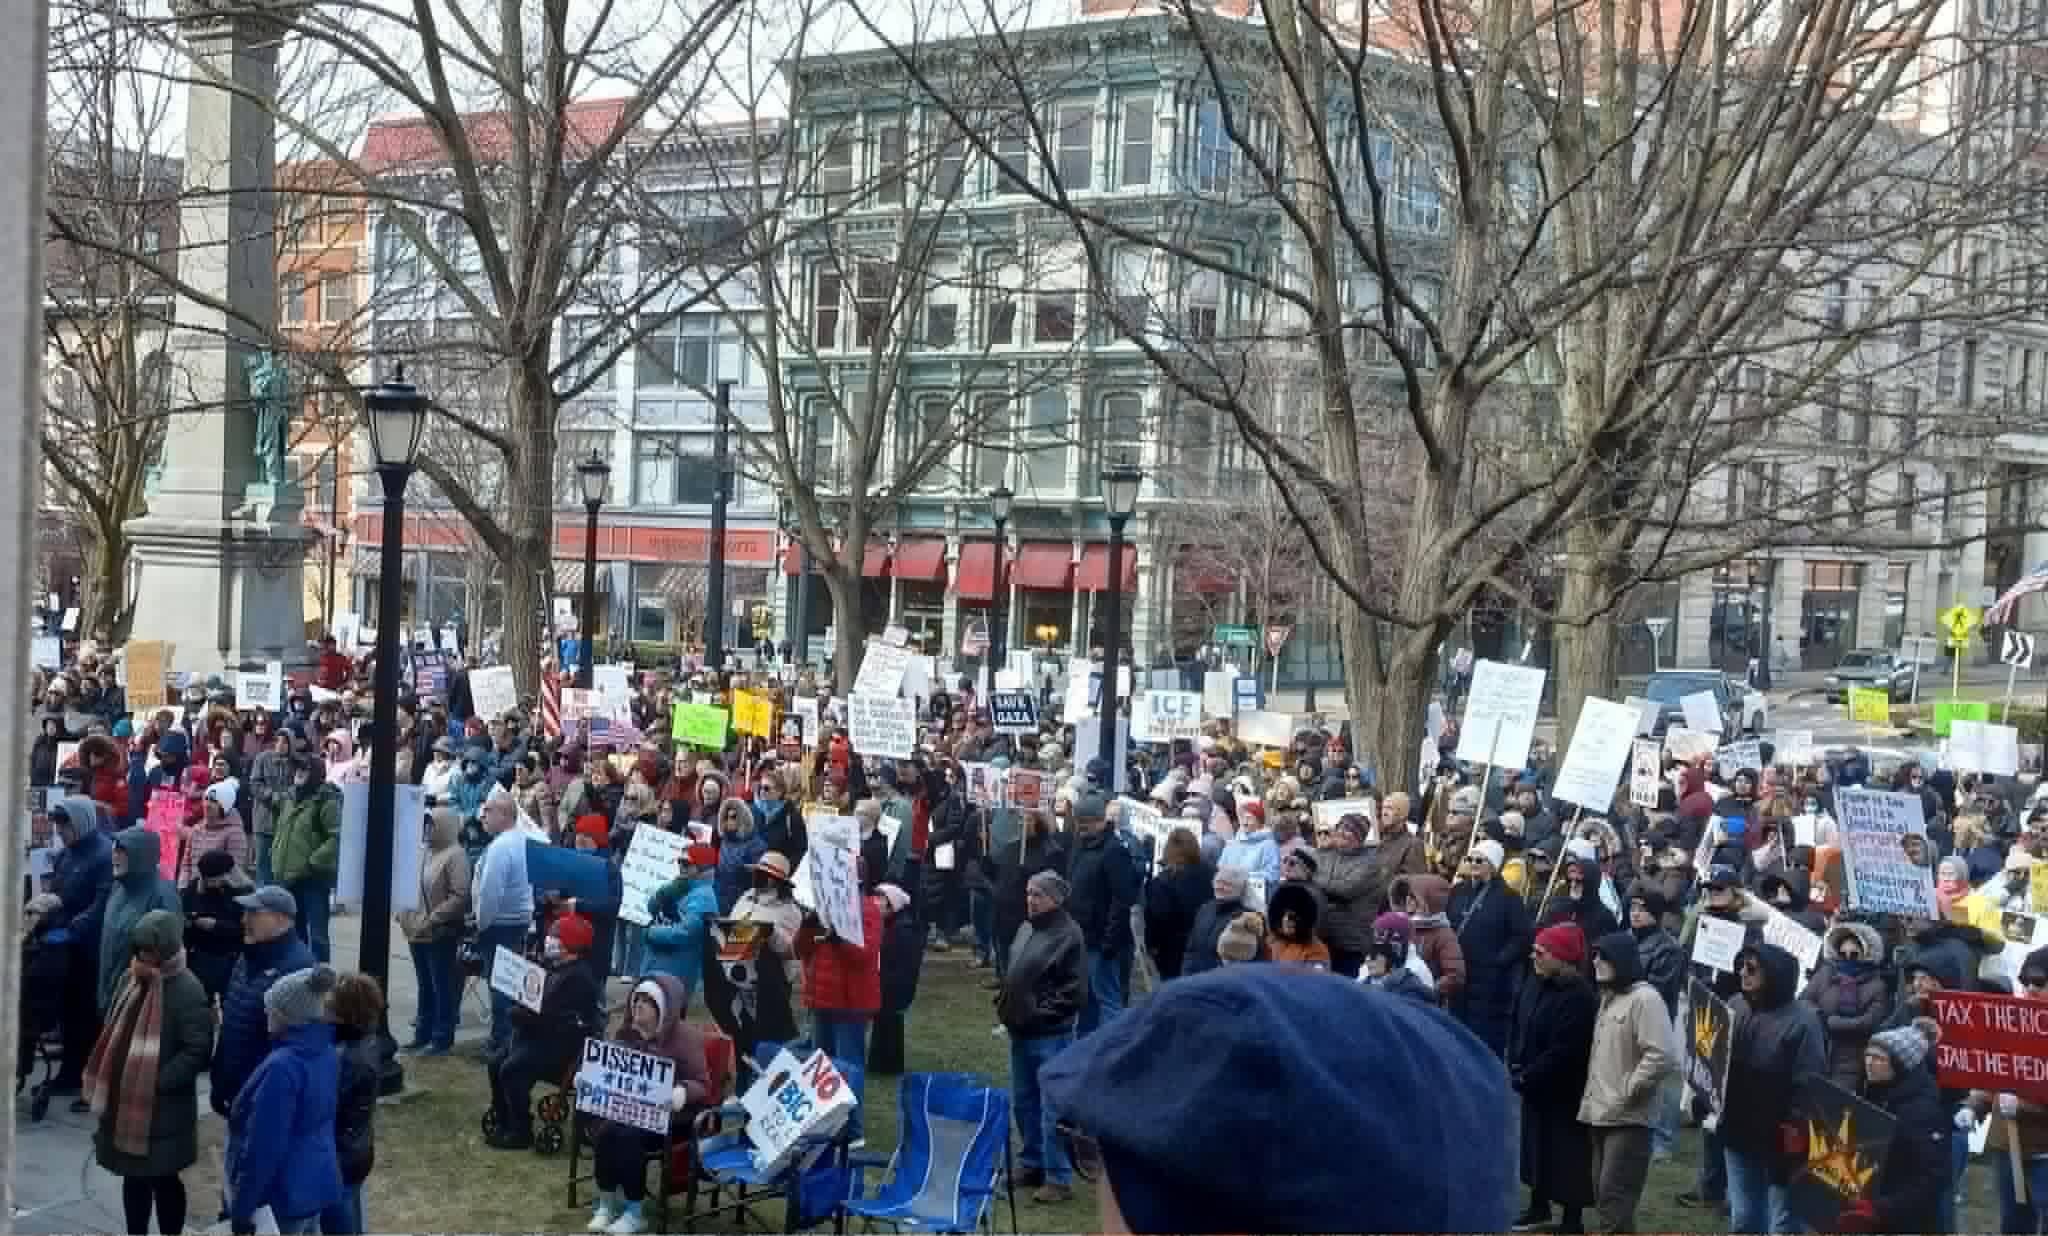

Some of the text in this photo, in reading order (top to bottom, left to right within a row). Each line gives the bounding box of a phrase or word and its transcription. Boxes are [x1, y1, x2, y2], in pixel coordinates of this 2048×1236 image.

[1152, 695, 1192, 716] ICE
[1936, 1000, 1975, 1027] TAX
[1977, 1002, 2018, 1032] THE
[586, 1039, 672, 1083] DISSENT
[1937, 1045, 1974, 1072] JAIL
[1974, 1048, 2008, 1076] THE
[802, 1054, 841, 1101] NO
